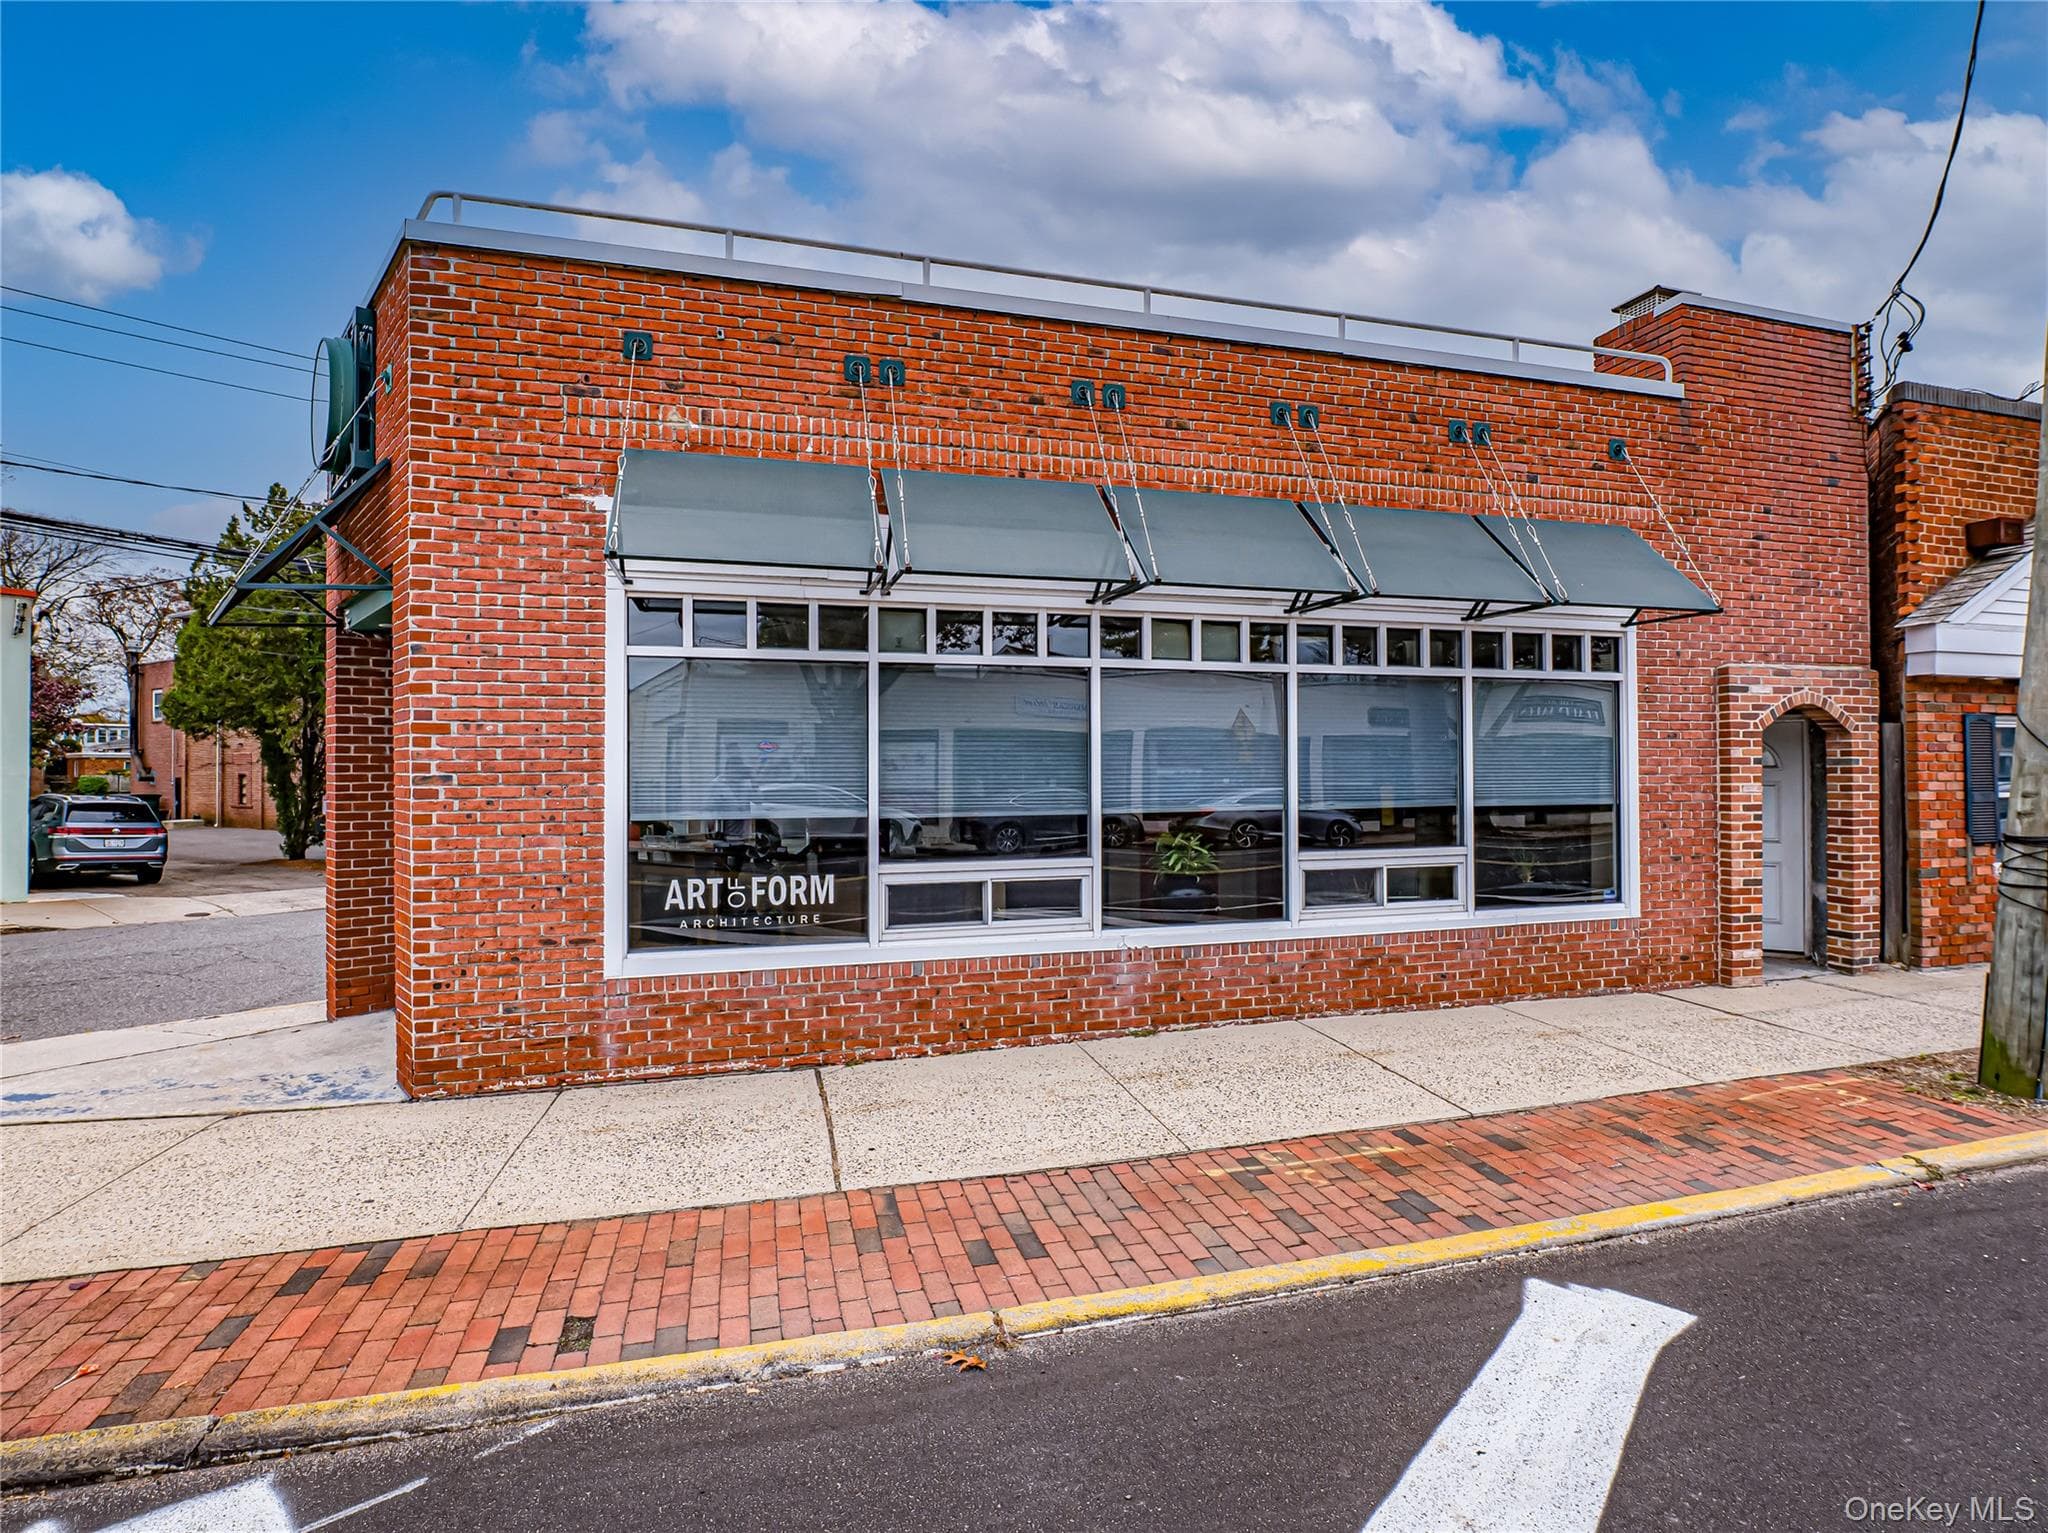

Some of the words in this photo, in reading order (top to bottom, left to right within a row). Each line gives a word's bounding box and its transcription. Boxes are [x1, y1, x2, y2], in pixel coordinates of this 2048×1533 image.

[664, 877, 723, 911] ART
[727, 878, 746, 909] OF
[751, 874, 835, 907] FORM
[679, 913, 821, 930] ARCHITECTURE
